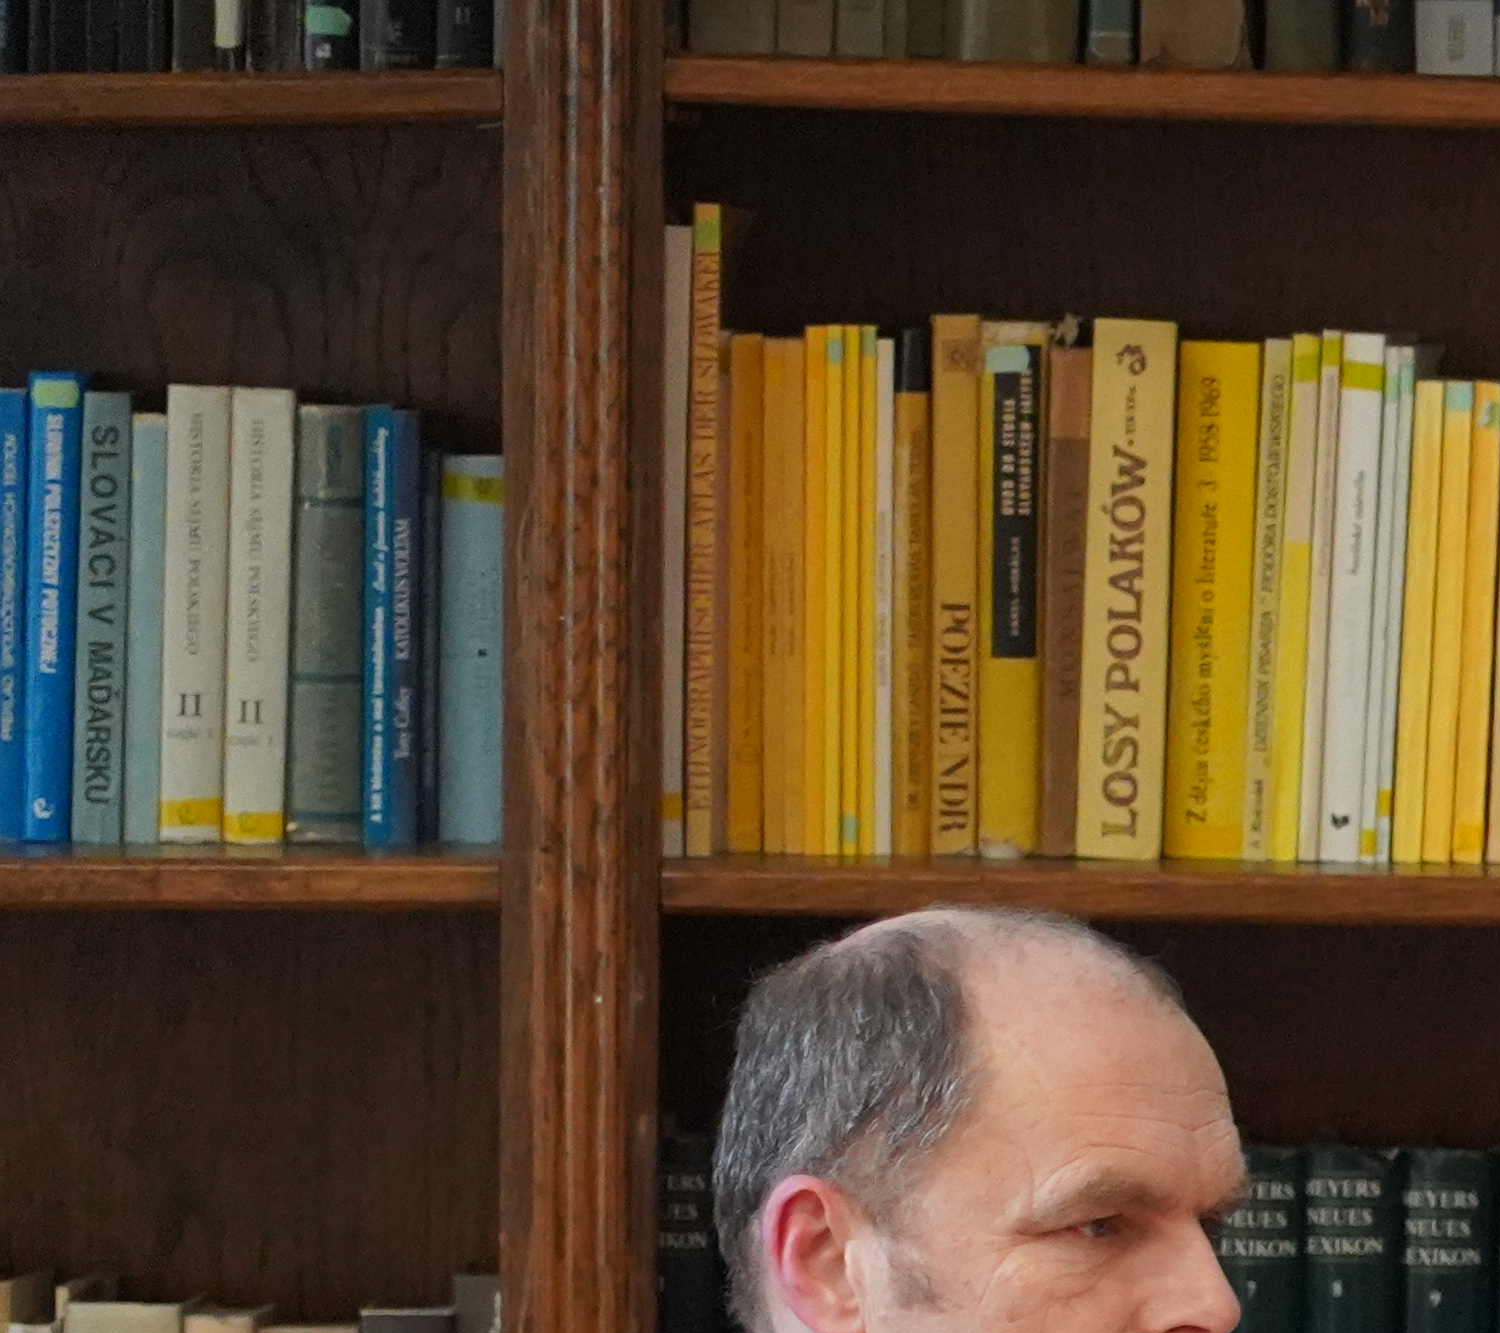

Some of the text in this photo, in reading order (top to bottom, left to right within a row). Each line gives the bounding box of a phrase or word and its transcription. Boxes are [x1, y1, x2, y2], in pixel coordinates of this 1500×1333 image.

[83, 425, 124, 806] SLOVÁCI V MAĎARSKU
[938, 602, 971, 833] POEZIE NDR
[1099, 446, 1149, 838] LOSY POLAKÓW
[1428, 1288, 1443, 1309] 9
